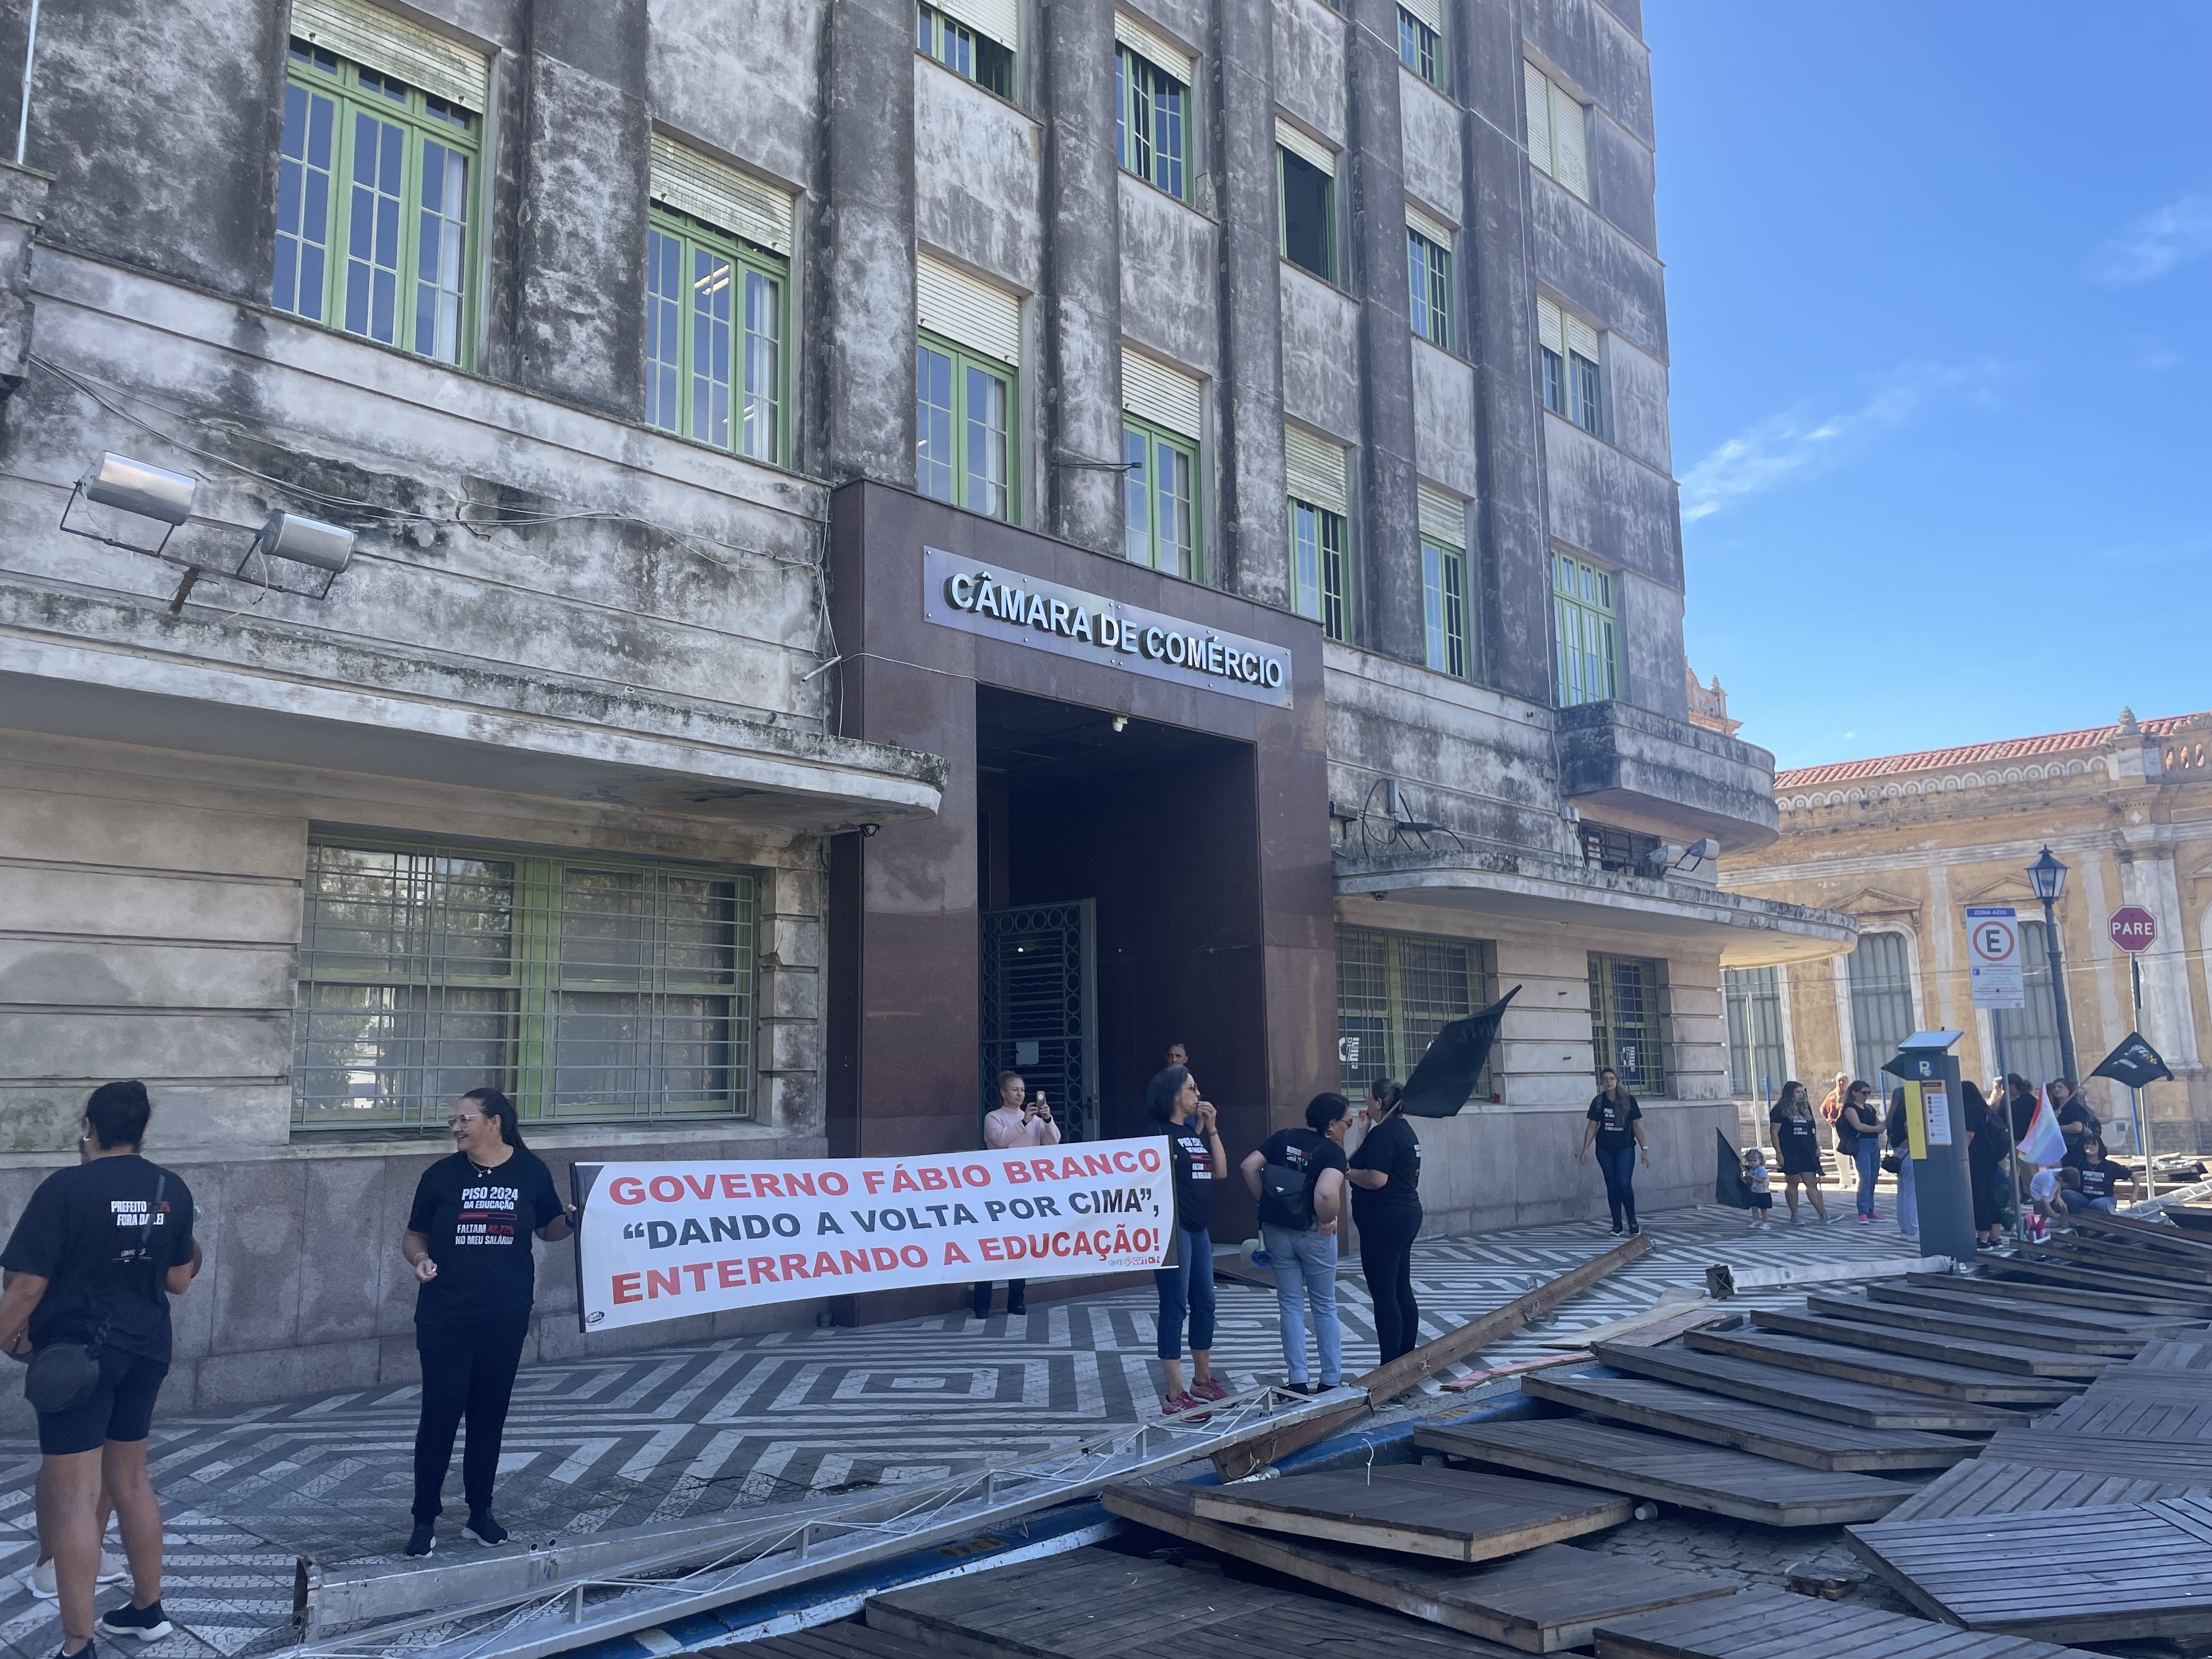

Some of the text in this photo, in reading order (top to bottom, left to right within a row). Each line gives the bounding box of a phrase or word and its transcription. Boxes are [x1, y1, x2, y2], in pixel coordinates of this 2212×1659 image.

[945, 571, 1283, 688] CÂMARA DE COMÉRCIO
[2112, 922, 2153, 935] PARE
[1985, 929, 2001, 952] E
[610, 1148, 1160, 1205] GOVERNO FÁBIO BRANCO
[461, 1186, 518, 1200] PISO 2024
[111, 1201, 147, 1212] PREFEITO
[463, 1200, 514, 1210] DA EDUCAÇÃO
[117, 1214, 138, 1226] FORA
[623, 1188, 1159, 1249] “DANDO A VOLTA POR CIMA”,
[457, 1224, 487, 1233] FALTAM
[455, 1235, 465, 1245] NO
[467, 1235, 483, 1245] MEU
[612, 1223, 1159, 1305] ENTERRANDO A EDUCAÇÃO!
[1133, 1256, 1147, 1266] CUT
